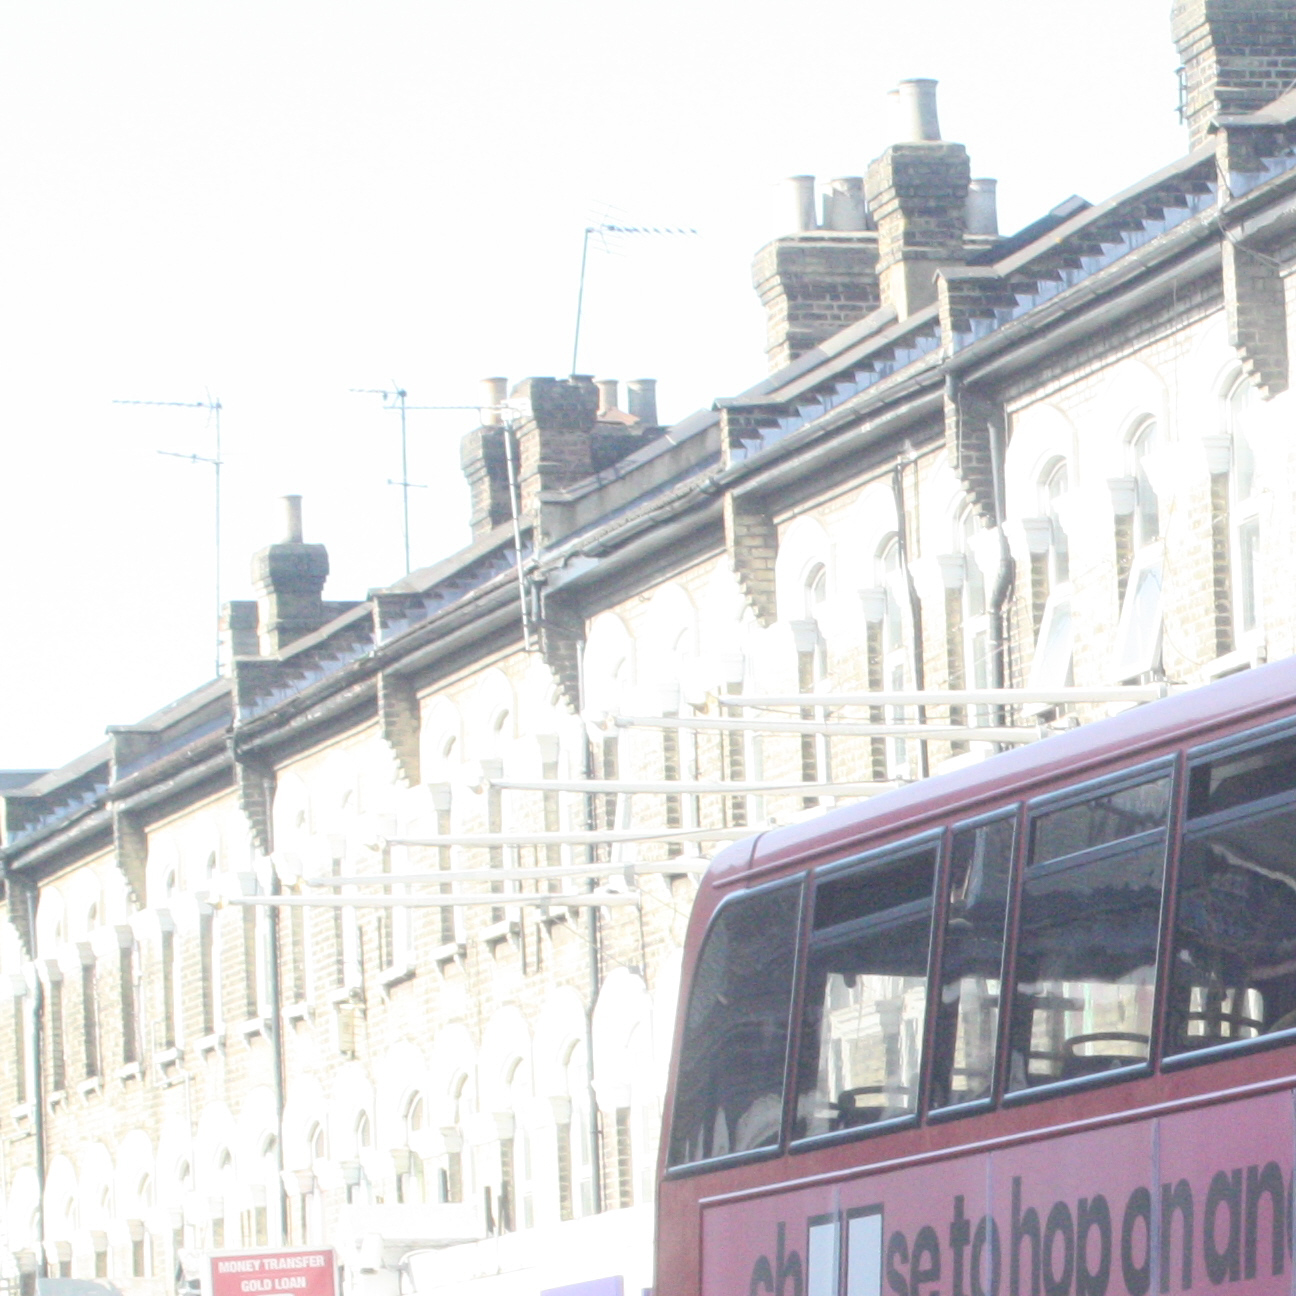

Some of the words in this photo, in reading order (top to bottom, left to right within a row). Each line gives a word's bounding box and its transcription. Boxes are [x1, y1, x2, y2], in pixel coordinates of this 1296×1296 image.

[217, 1259, 262, 1274] MONEY
[262, 1255, 326, 1271] TRANSFER
[241, 1279, 272, 1292] GOLD
[275, 1276, 307, 1290] LOAN
